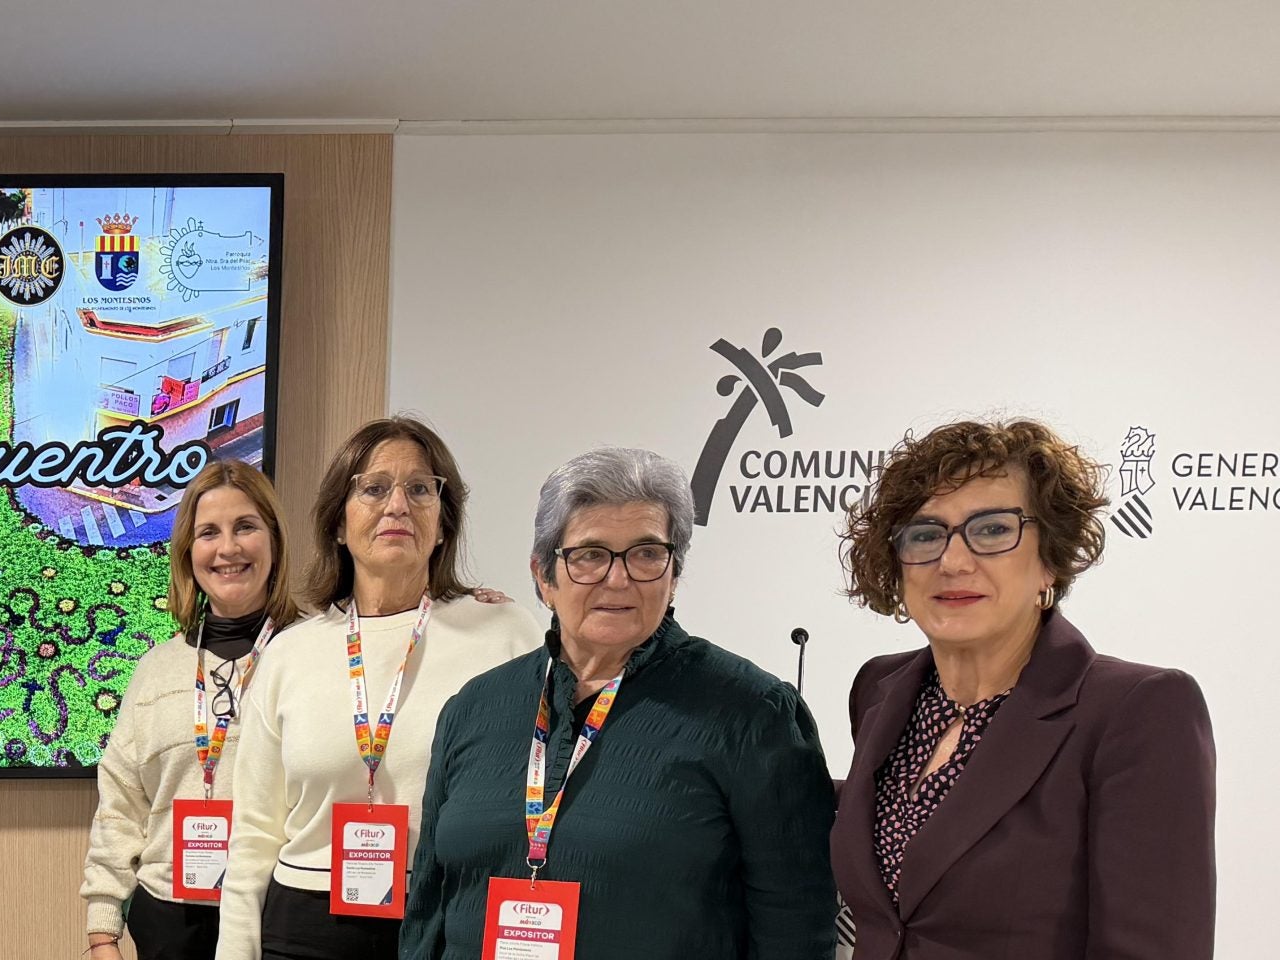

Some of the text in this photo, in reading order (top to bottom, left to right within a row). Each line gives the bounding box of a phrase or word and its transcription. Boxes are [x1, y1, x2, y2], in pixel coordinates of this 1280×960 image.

[111, 392, 139, 403] POLLOS
[114, 399, 134, 408] PACO
[739, 450, 900, 479] COMUNI
[348, 851, 391, 859] EXPOSITOR
[503, 928, 555, 940] EXPOSITOR
